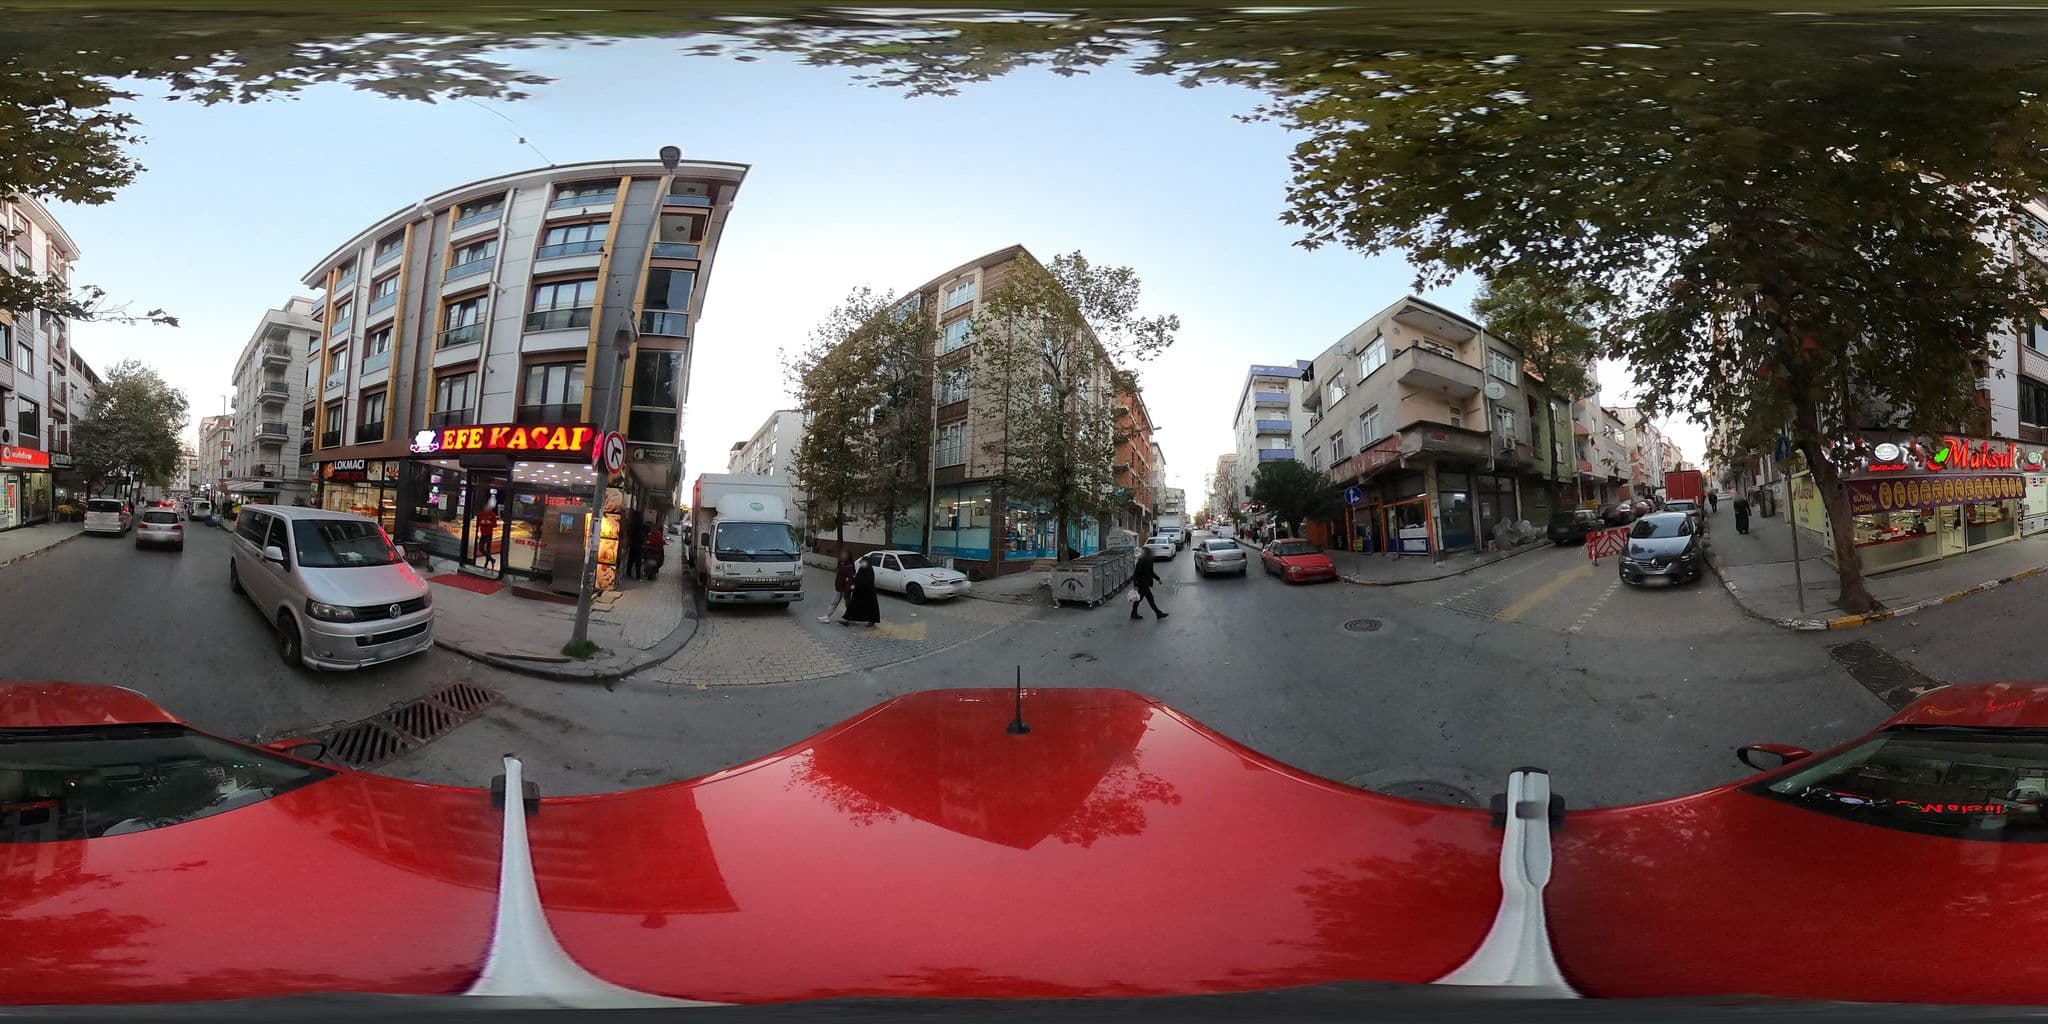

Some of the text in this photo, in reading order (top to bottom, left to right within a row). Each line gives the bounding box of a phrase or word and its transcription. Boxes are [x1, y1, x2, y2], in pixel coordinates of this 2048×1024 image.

[441, 427, 485, 450] EFE
[487, 426, 593, 451] KASAP
[1944, 438, 2016, 469] Maksul
